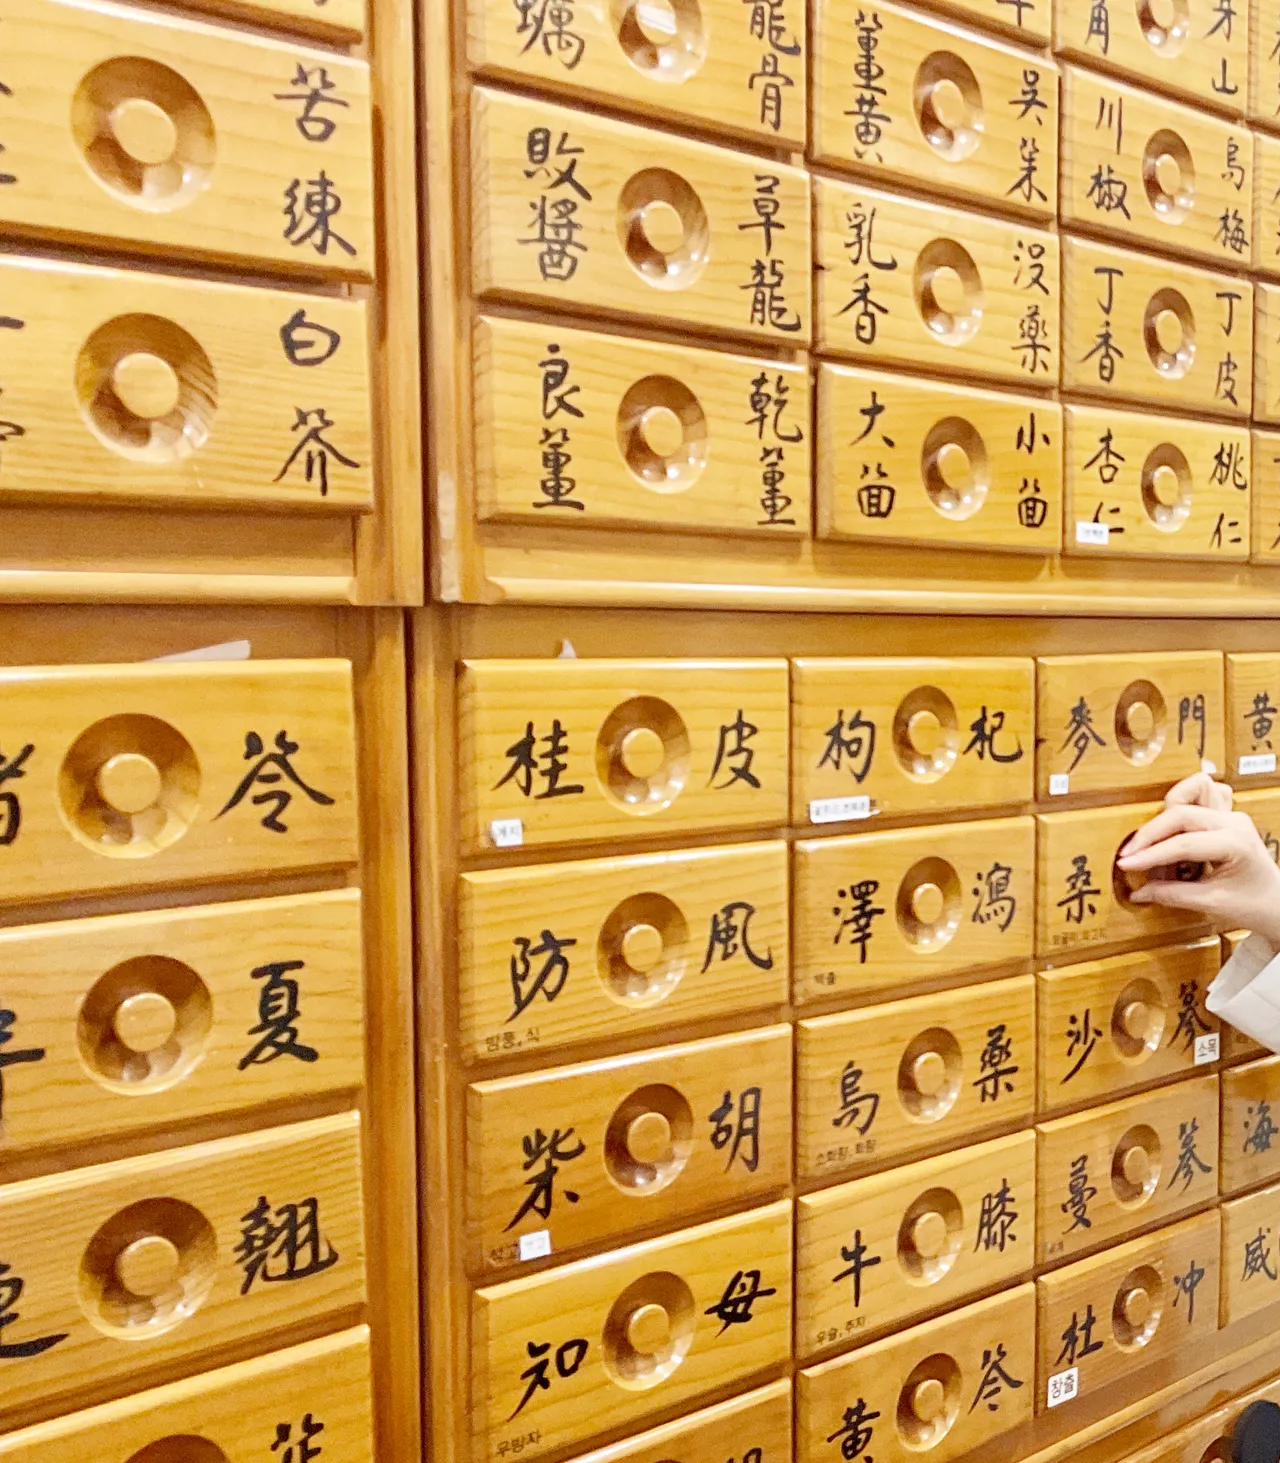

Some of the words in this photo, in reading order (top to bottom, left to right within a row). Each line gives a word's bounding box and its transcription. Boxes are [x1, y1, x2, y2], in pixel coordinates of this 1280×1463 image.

[1080, 267, 1125, 384] 丁香
[1208, 441, 1249, 551] 桃仁
[490, 718, 586, 800] 桂
[704, 708, 762, 790] 皮
[1177, 693, 1207, 760] 門
[504, 928, 578, 1024] 防
[700, 900, 774, 975] 風
[237, 959, 320, 1072] 夏
[707, 1085, 763, 1175] 胡
[831, 1228, 883, 1309] 牛
[506, 1337, 590, 1423] 知
[703, 1269, 777, 1338] 母
[1053, 1303, 1105, 1369] 杜
